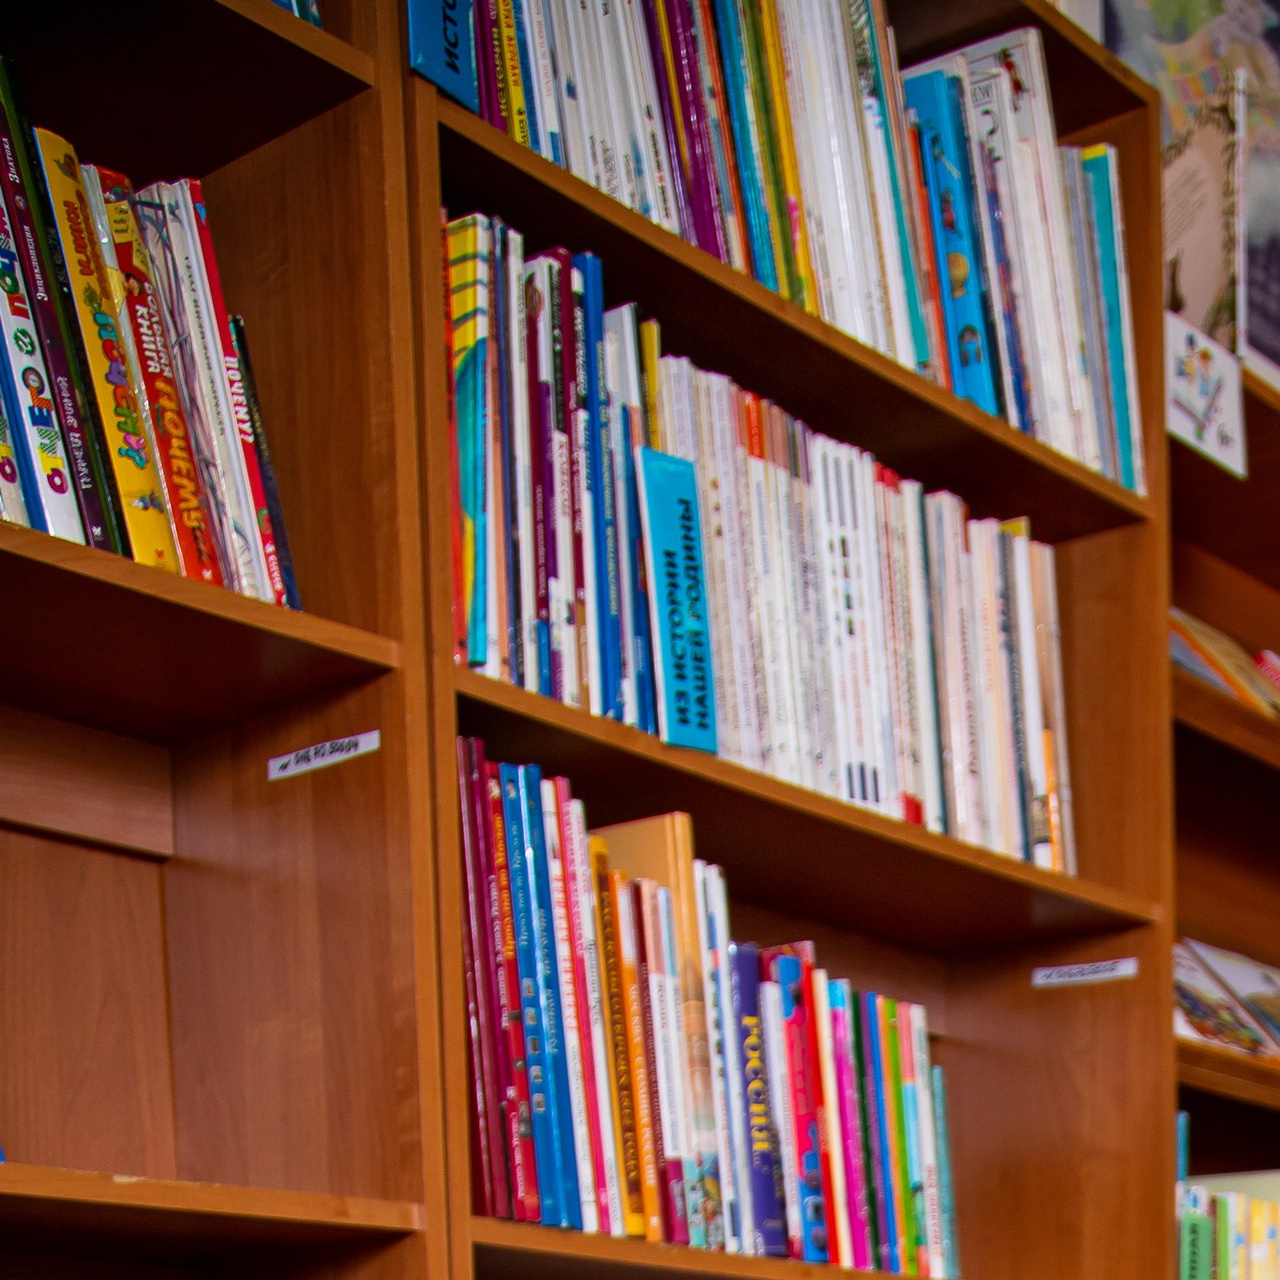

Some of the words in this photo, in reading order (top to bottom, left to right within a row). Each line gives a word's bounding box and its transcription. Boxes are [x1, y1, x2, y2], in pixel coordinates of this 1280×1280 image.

[135, 303, 161, 374] КНИГА
[21, 365, 70, 495] ОТЧЕГО
[660, 548, 690, 681] ИСТОРИИ
[676, 496, 704, 621] РОДИНЫ
[674, 689, 691, 726] ИЗ
[684, 629, 712, 730] НАШЕЙ
